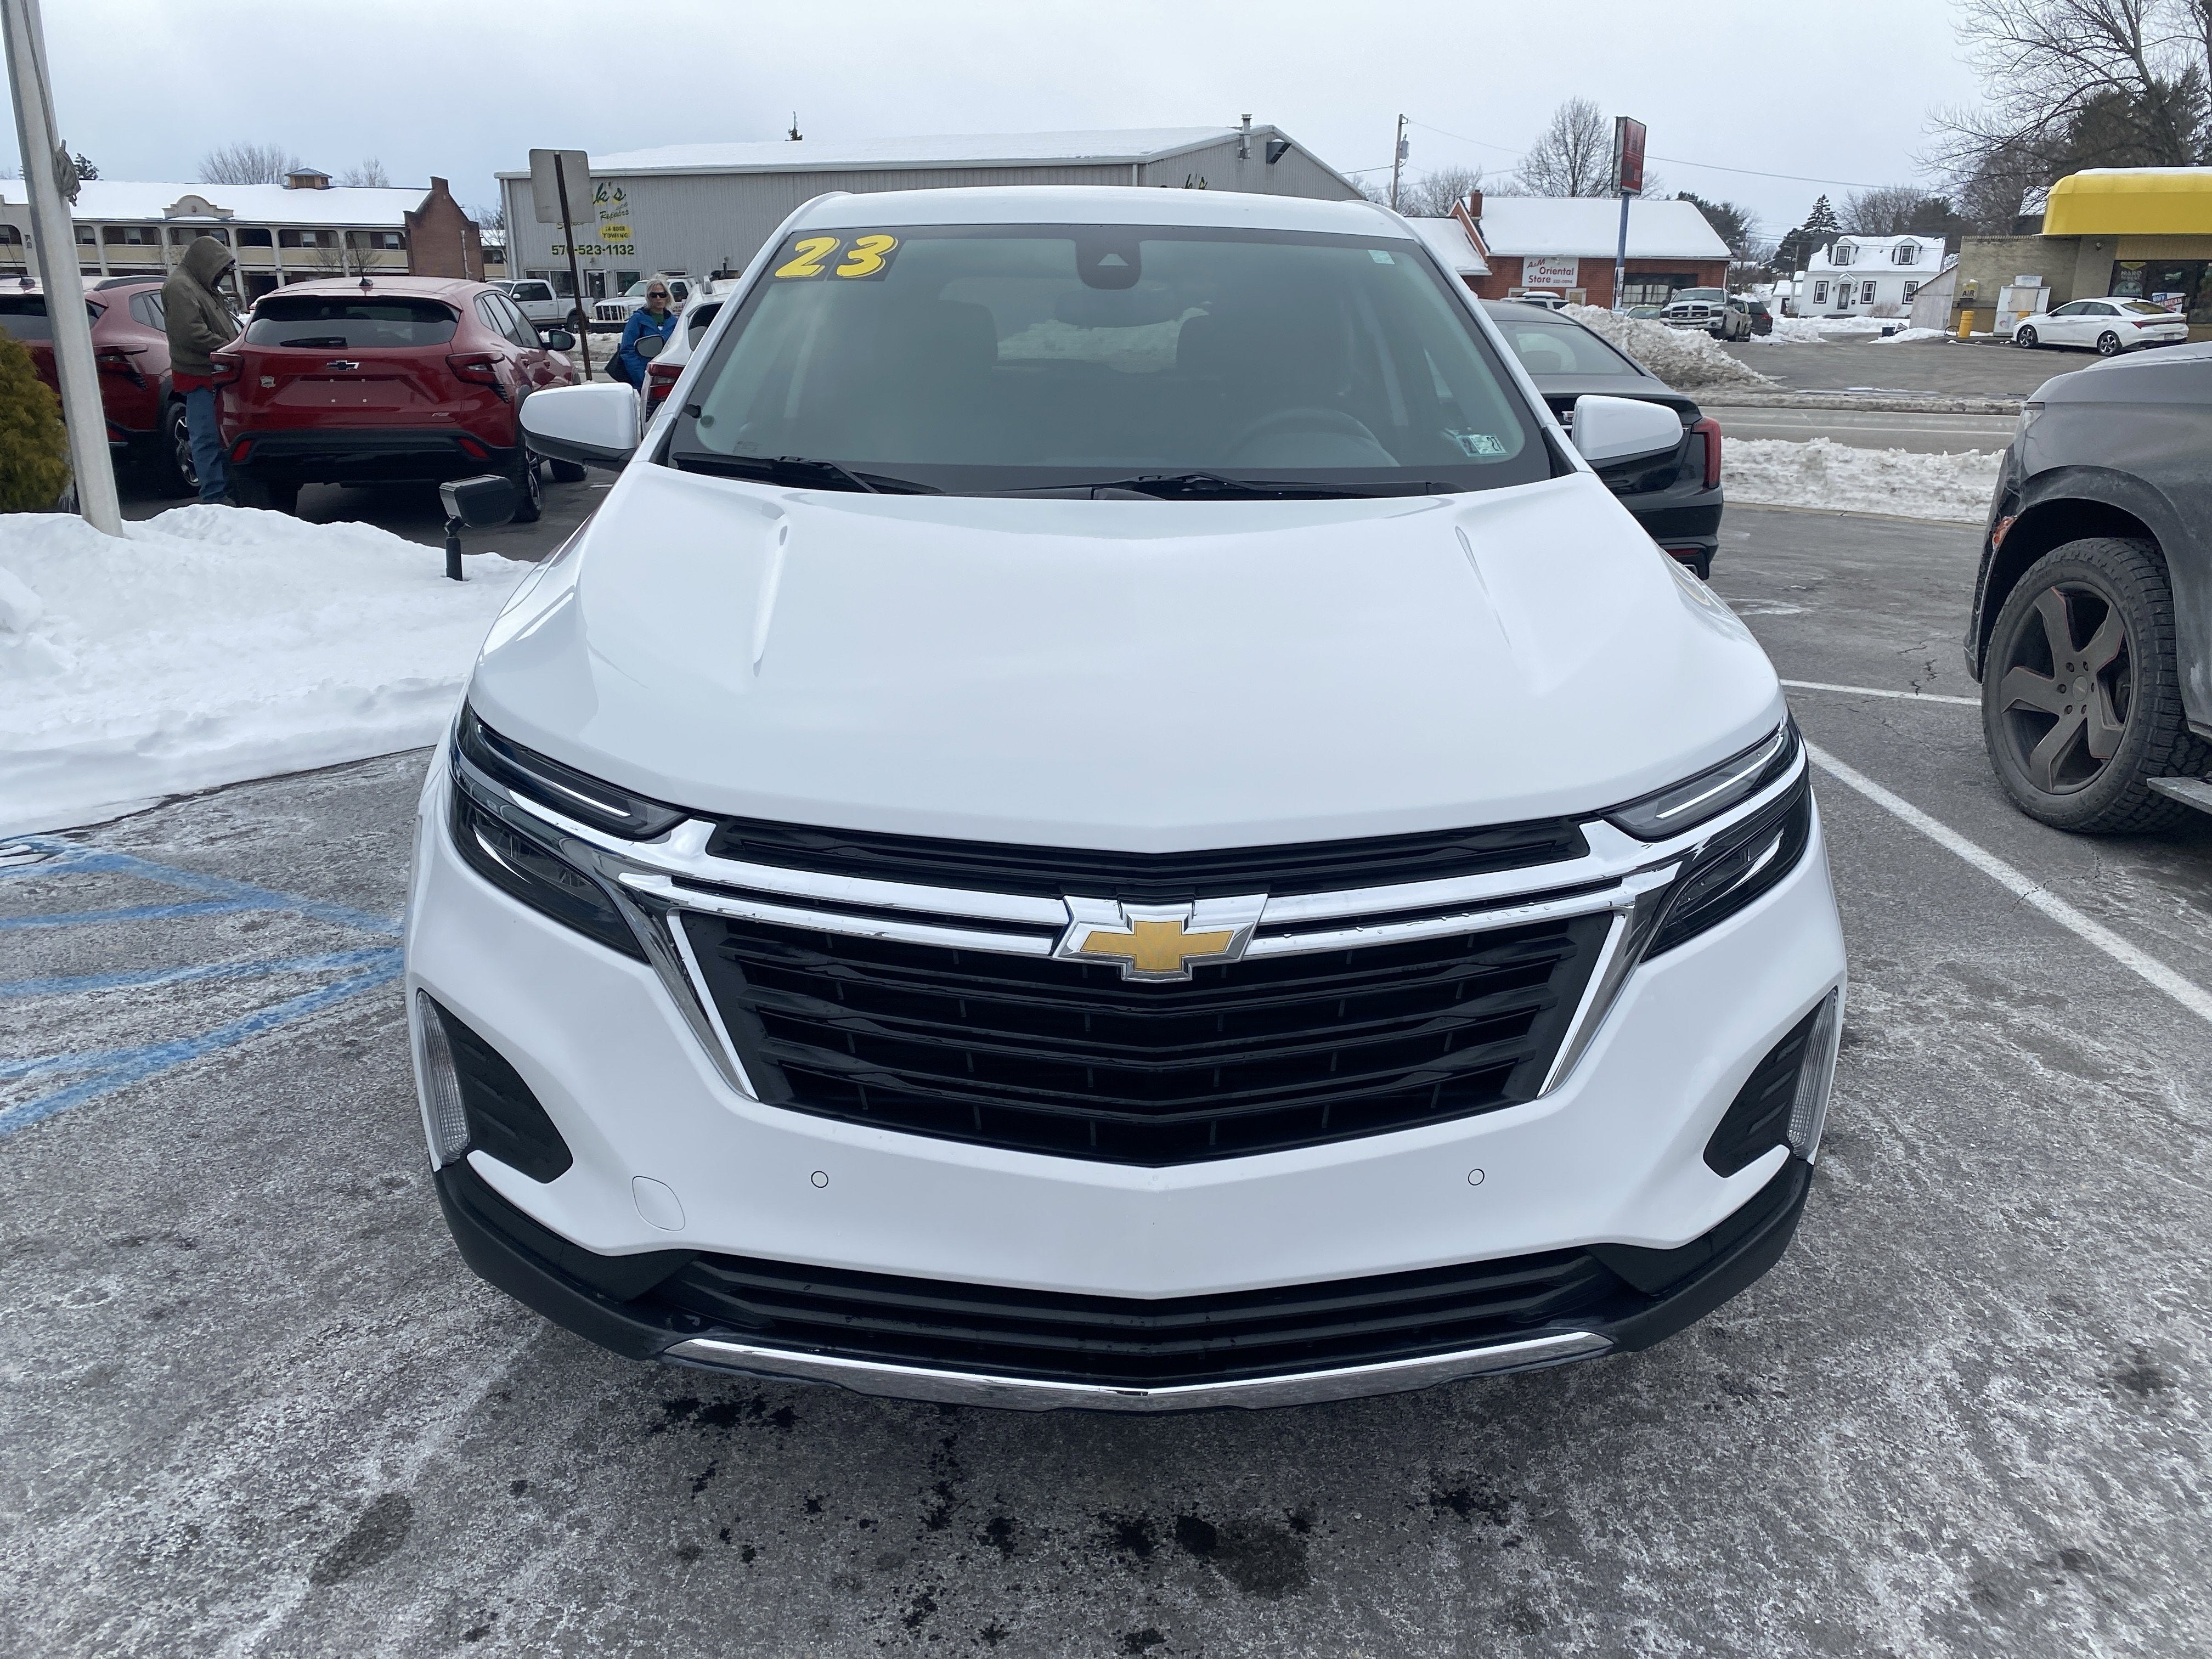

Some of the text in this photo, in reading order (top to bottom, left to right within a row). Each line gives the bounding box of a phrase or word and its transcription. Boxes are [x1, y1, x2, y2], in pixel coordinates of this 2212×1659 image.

[552, 245, 635, 255] 57-523-1132
[775, 234, 899, 278] 23
[1539, 267, 1575, 275] Oriental
[1528, 275, 1551, 283] Store
